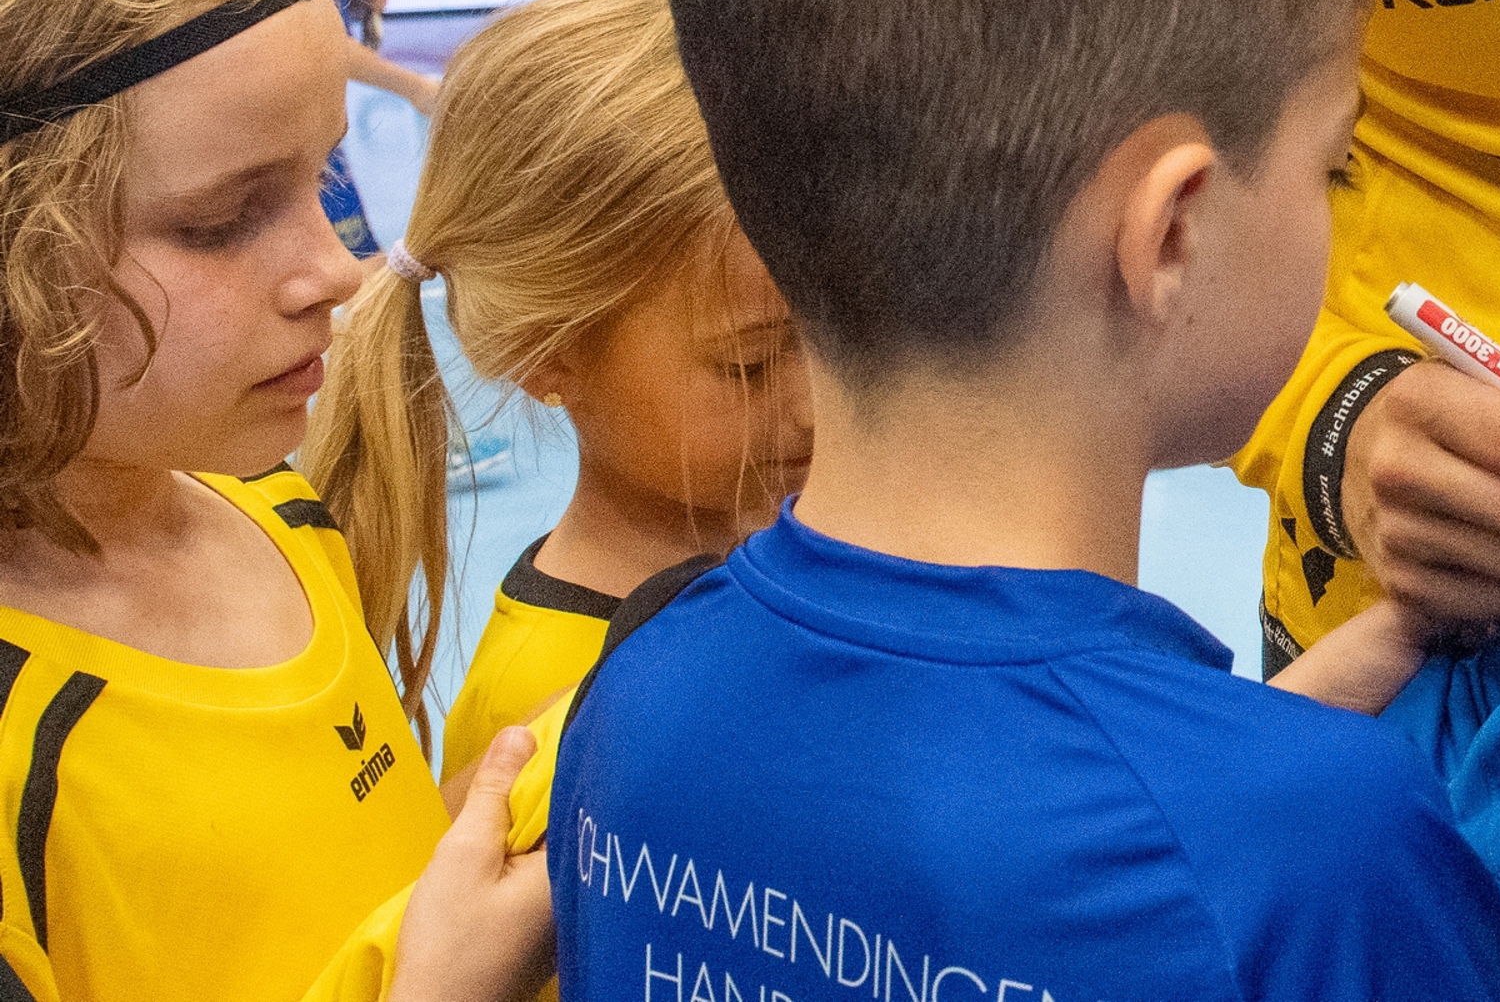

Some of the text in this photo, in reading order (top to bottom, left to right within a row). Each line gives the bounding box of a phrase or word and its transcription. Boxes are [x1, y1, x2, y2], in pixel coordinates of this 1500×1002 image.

[1440, 316, 1495, 361] 3000
[1320, 365, 1387, 458] #ächtbärn
[350, 742, 396, 803] erima
